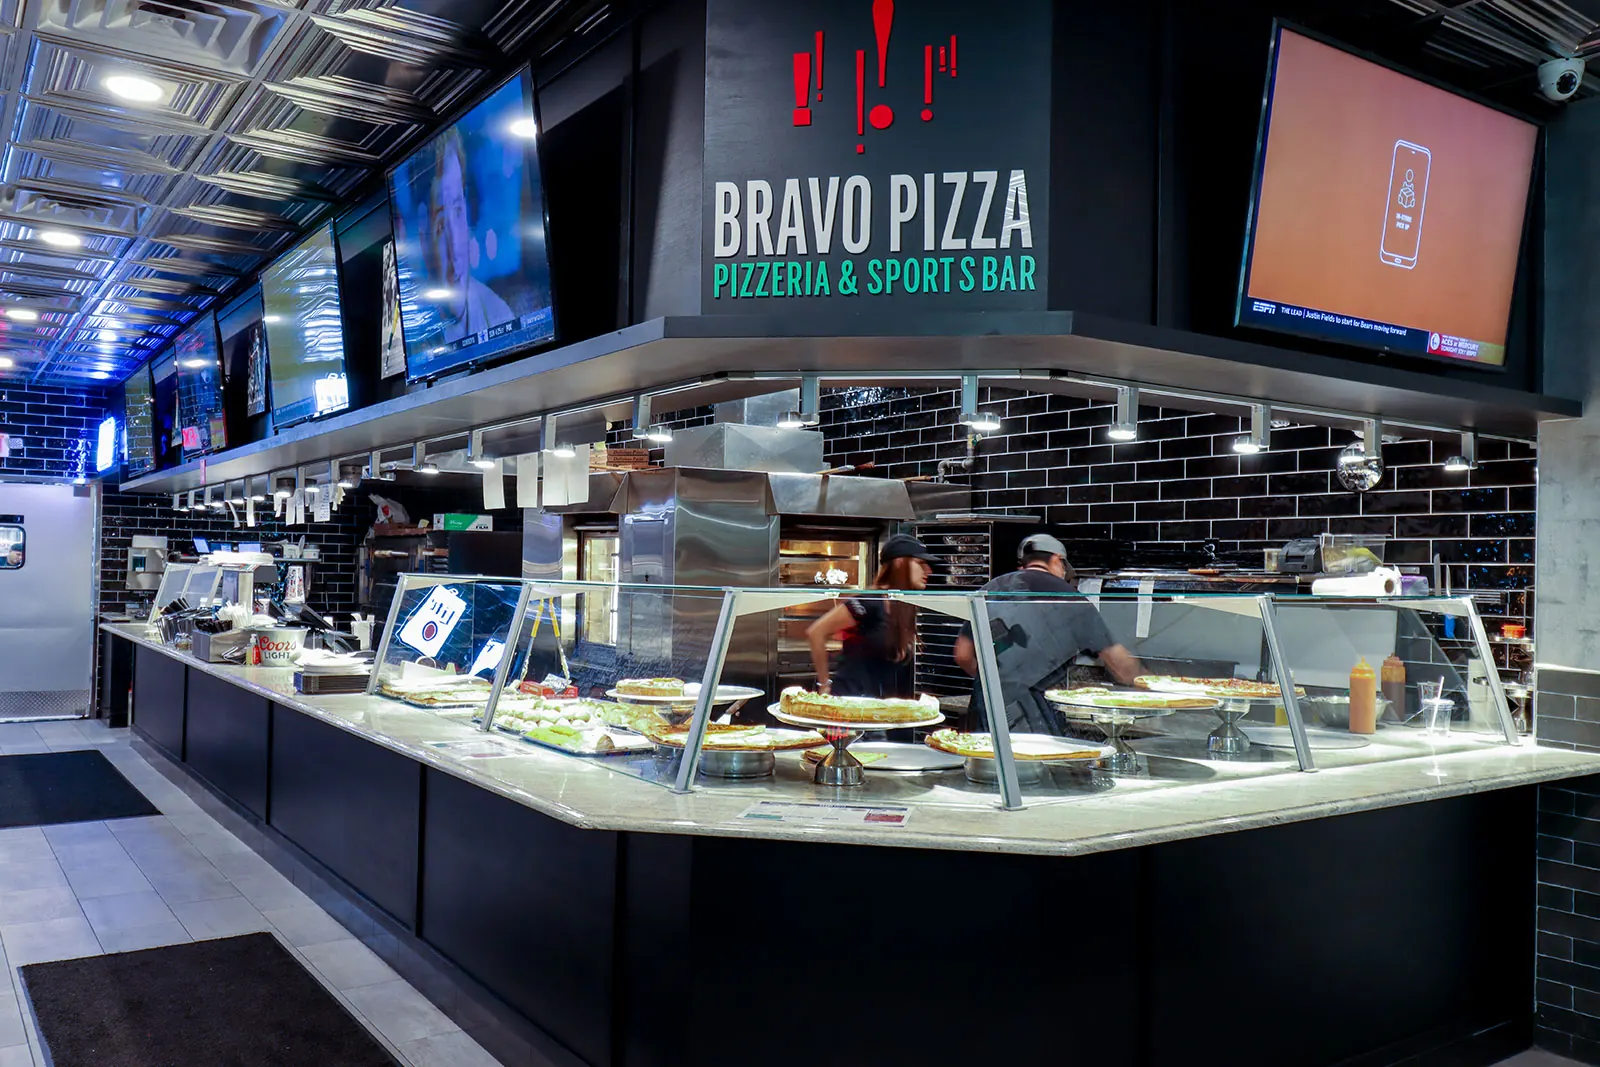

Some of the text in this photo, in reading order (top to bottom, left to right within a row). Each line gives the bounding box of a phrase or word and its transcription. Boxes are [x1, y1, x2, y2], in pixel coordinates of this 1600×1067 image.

[714, 169, 1033, 257] BRAVO PIZZA
[714, 255, 1036, 298] PIZZERIA & SPORTS BAR
[1252, 301, 1407, 336] ESPN THE LEAD Justin Fields to start for Bears moving forward
[1441, 338, 1453, 346] ACES
[259, 636, 297, 651] Coors
[264, 652, 291, 660] LIGHT
